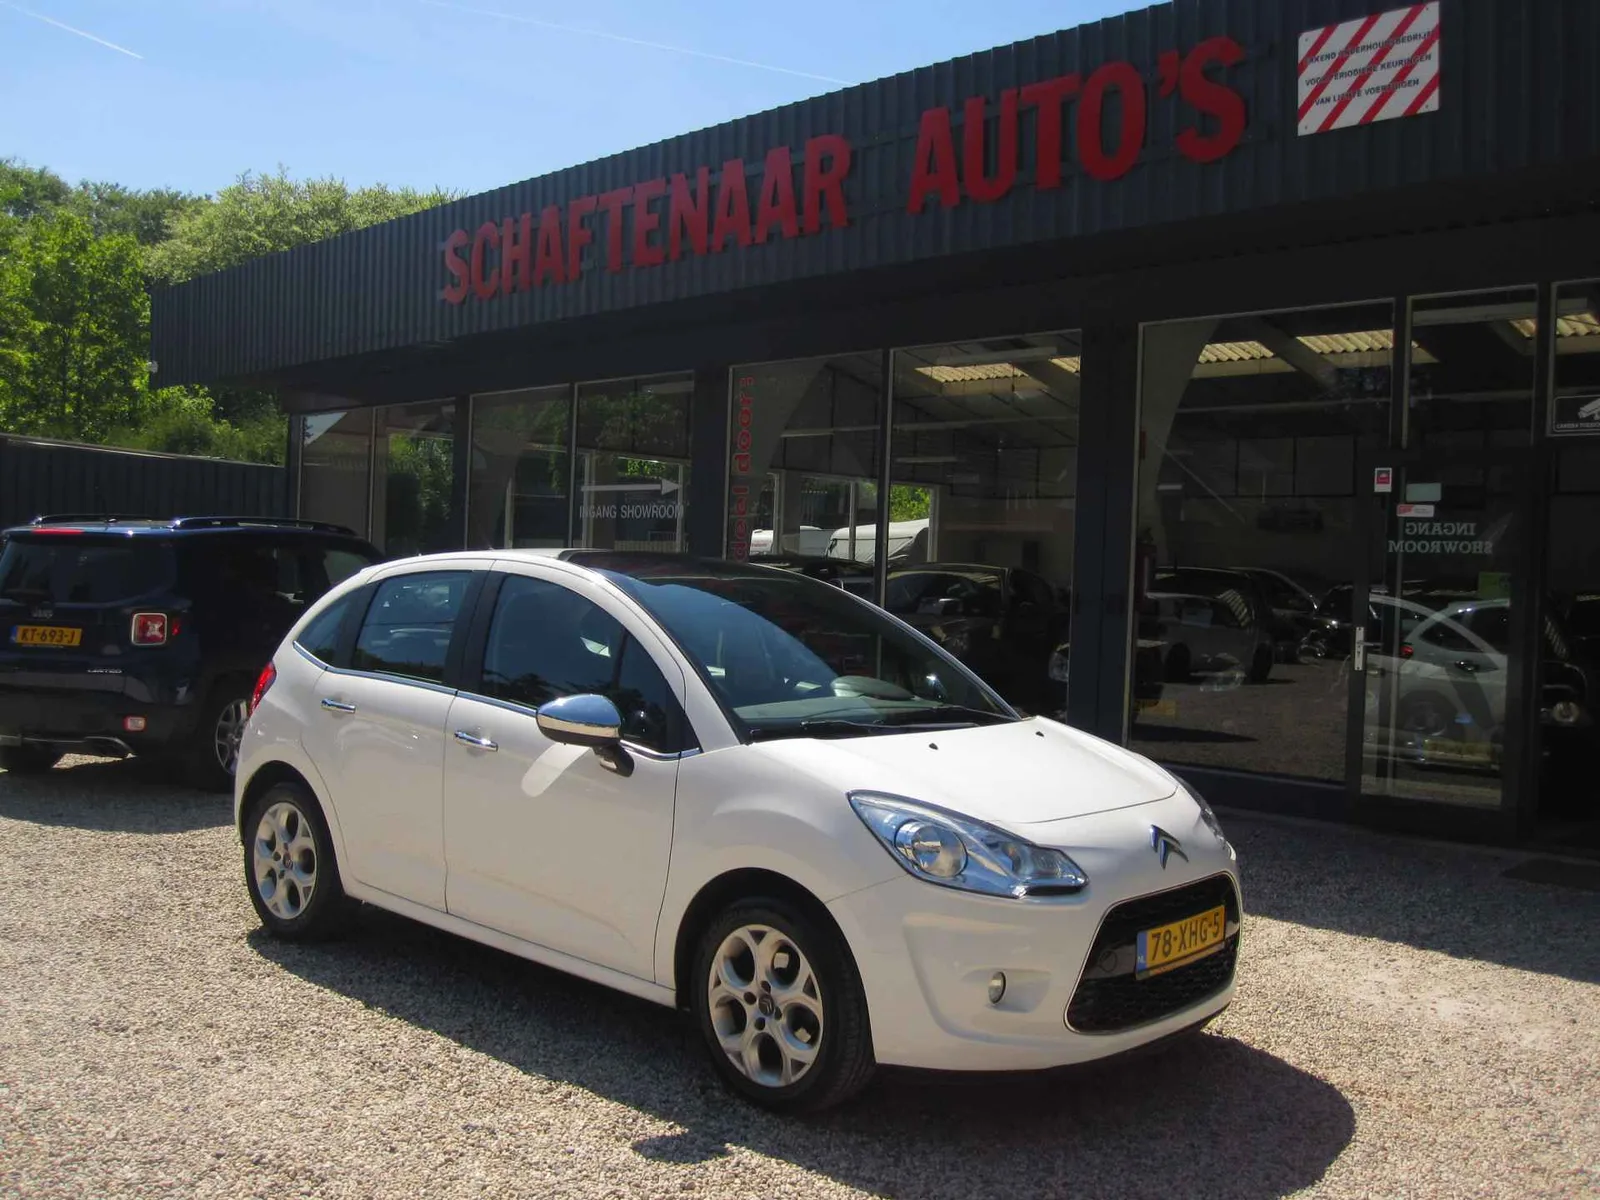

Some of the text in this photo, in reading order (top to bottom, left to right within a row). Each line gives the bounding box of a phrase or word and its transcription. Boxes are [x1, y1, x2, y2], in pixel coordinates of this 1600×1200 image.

[1329, 65, 1378, 81] ERIODIEKE
[1380, 54, 1432, 71] KEURINGEN
[1314, 96, 1331, 106] VAN
[1364, 78, 1420, 95] VOERTUIGEN
[442, 36, 1246, 306] SCHAFTENAAR AUTO'S
[580, 504, 684, 519] INGANG SHOWROOM
[21, 628, 76, 644] KT-693-J
[1151, 912, 1220, 960] 78-XHG-5
